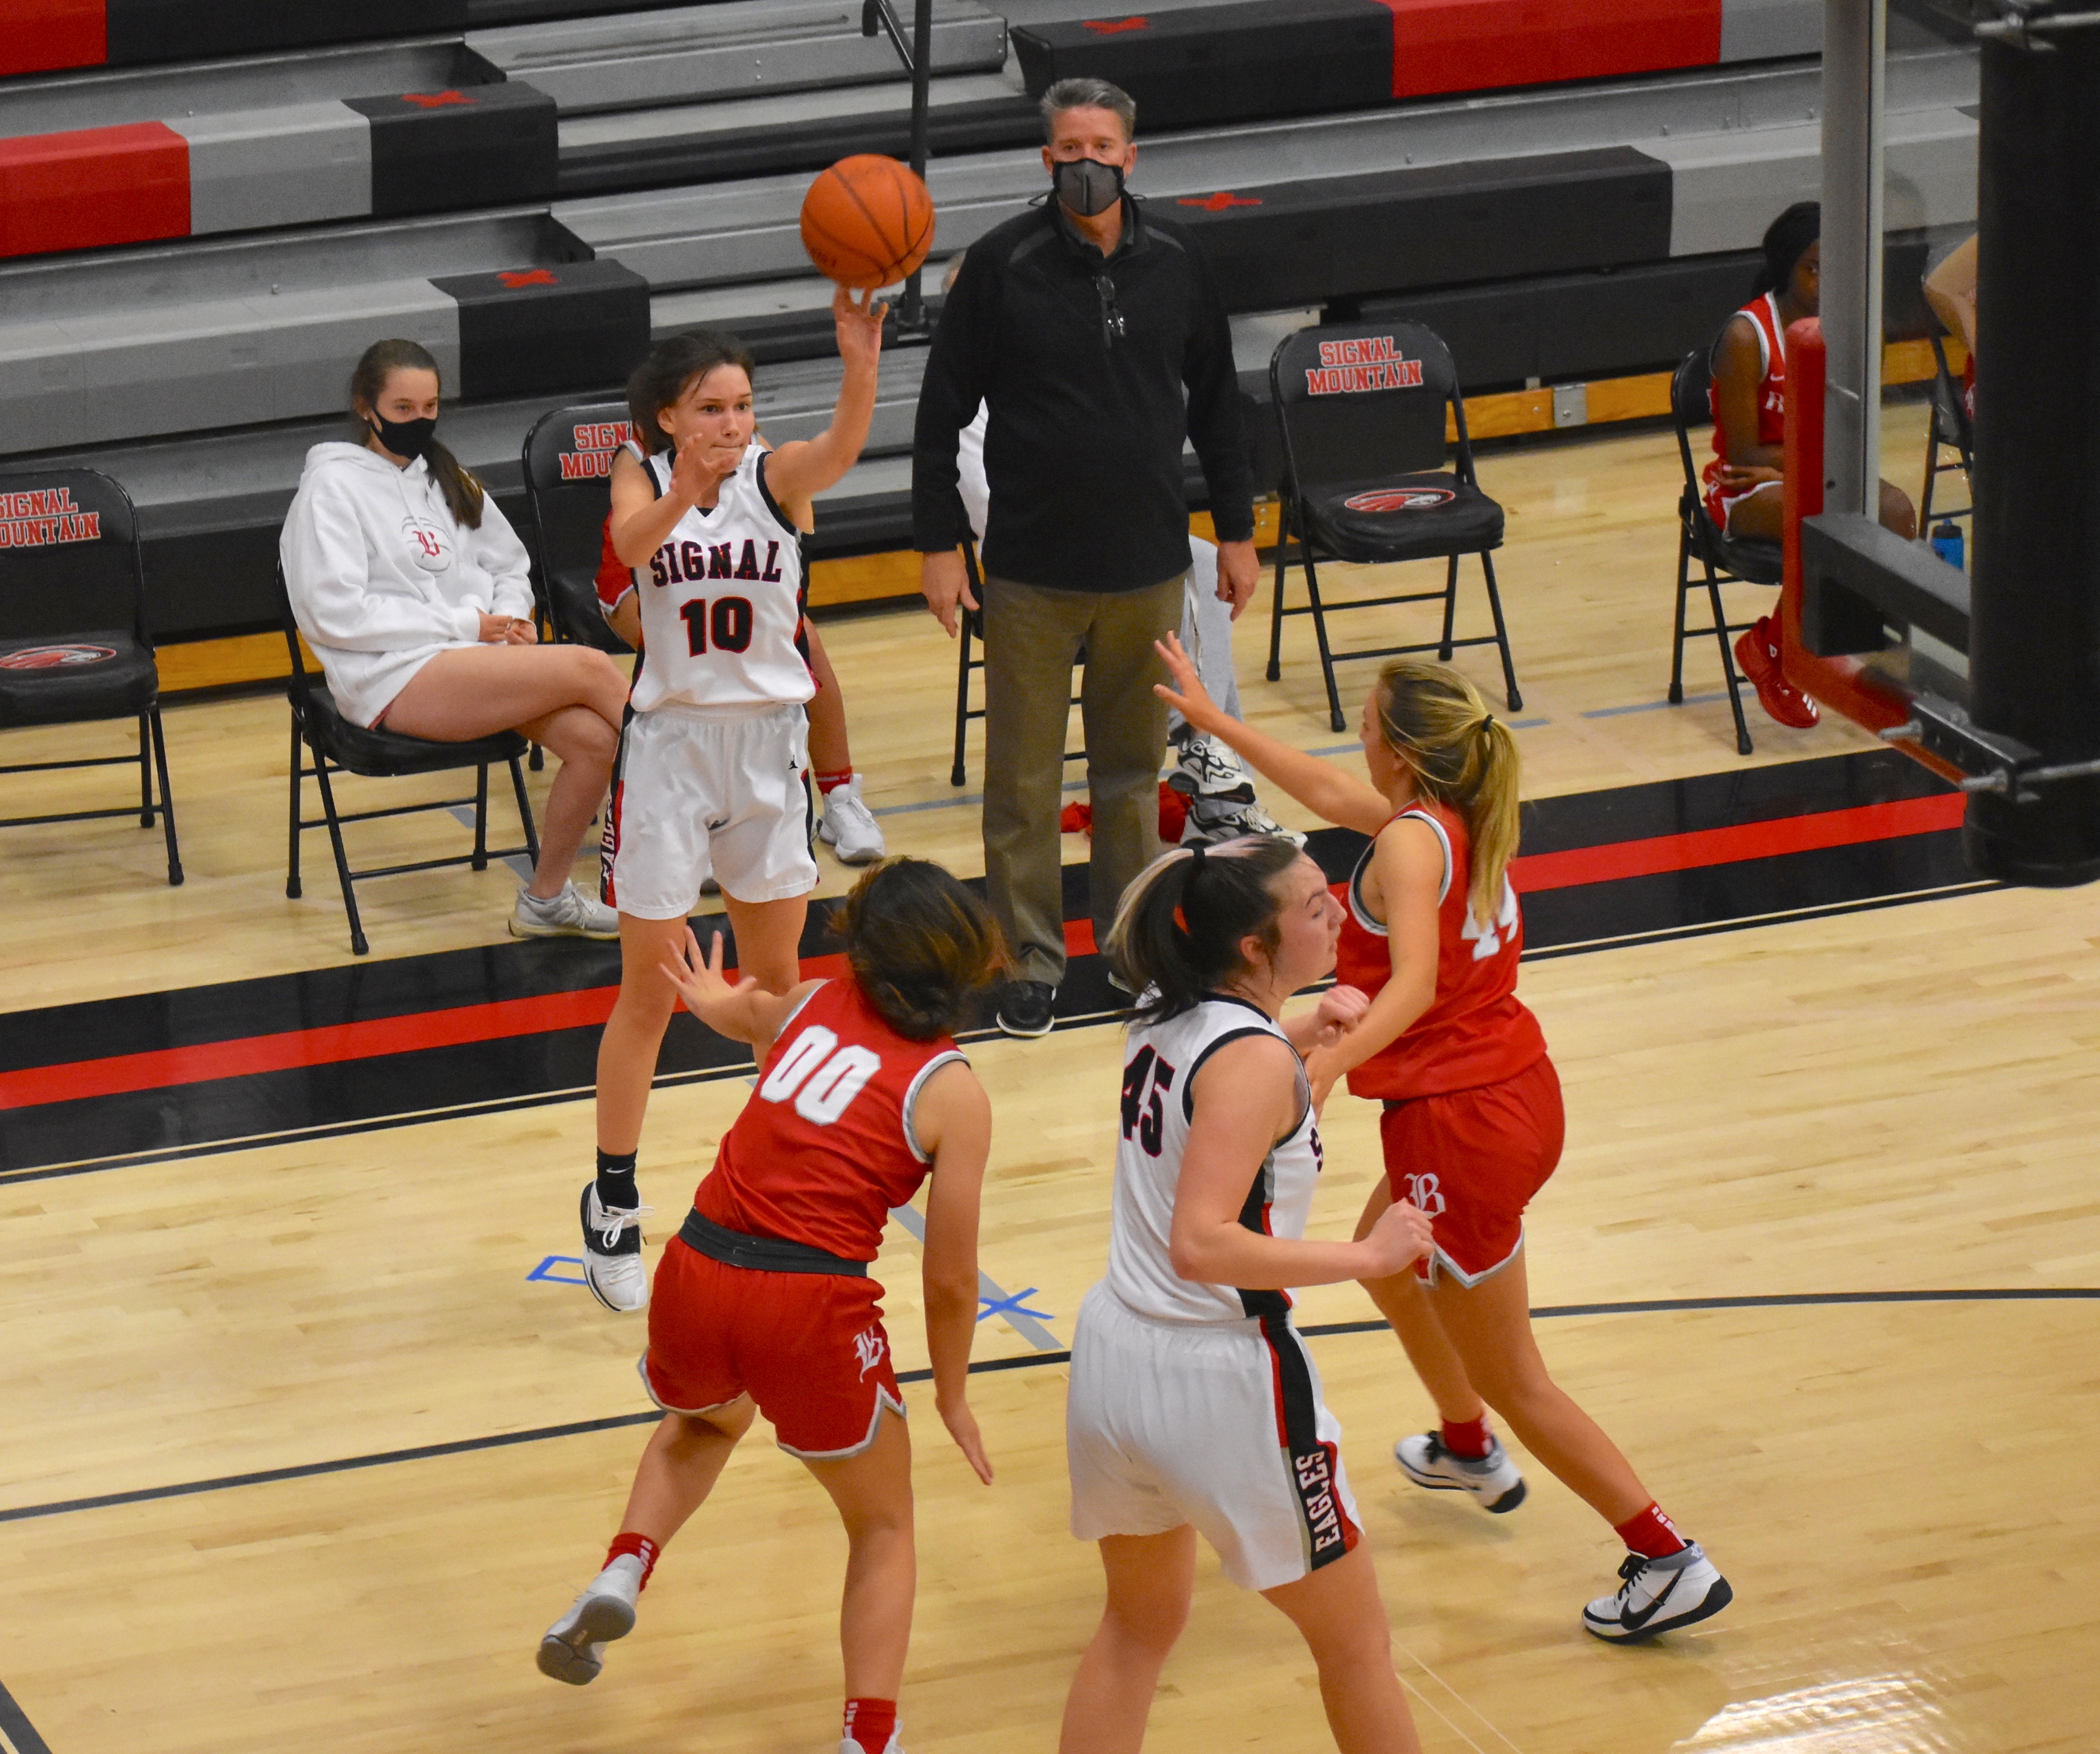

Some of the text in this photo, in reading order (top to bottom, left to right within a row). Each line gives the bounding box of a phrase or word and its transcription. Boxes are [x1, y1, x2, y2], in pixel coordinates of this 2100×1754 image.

[1306, 360, 1423, 395] MOUNTAIN
[1319, 336, 1402, 367] SIGNAL
[0, 512, 101, 548] OUNTAIN
[649, 539, 782, 588] SIGNAL
[680, 596, 753, 658] 10
[759, 1024, 882, 1126] 00
[1121, 1043, 1175, 1157] 45
[1295, 1450, 1340, 1552] EAGLES
